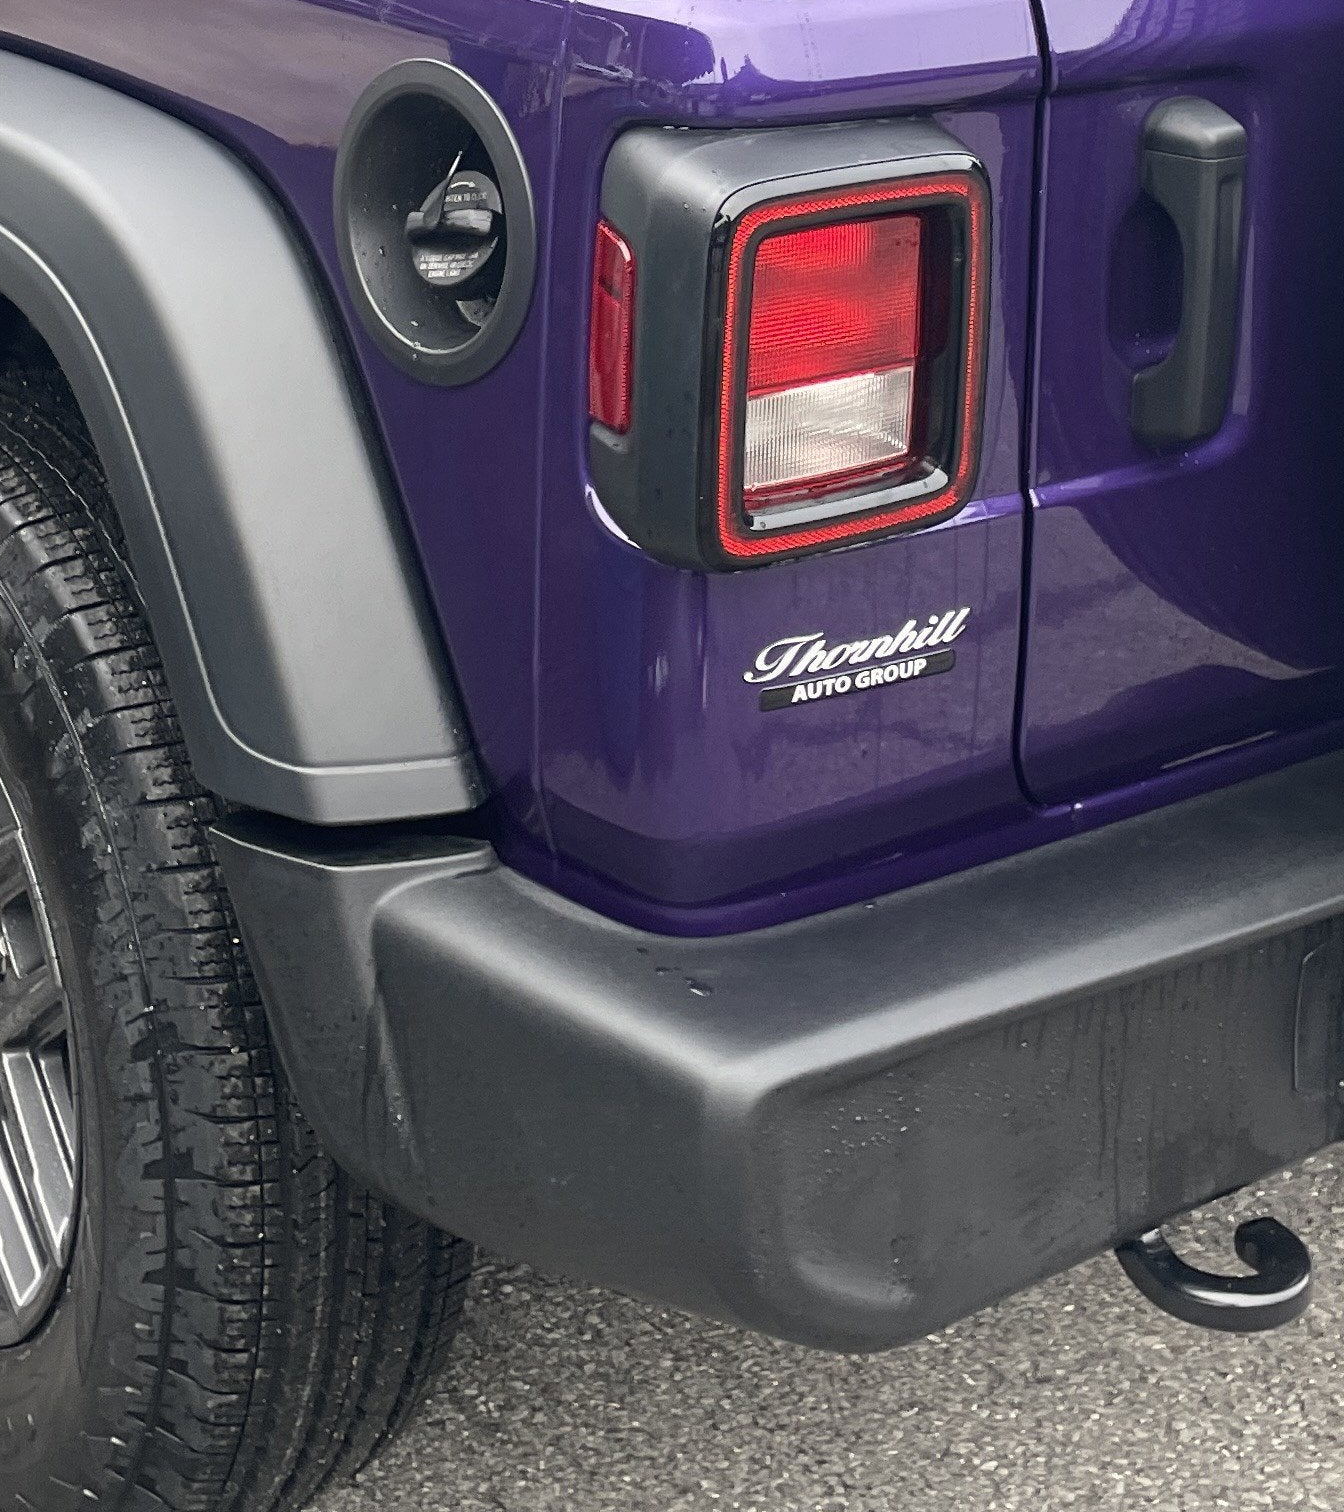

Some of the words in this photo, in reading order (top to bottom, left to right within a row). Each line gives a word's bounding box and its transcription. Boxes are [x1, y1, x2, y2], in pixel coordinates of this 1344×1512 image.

[743, 606, 972, 684] Thornhill
[791, 676, 852, 704] AUTO
[854, 658, 928, 691] GROUP
